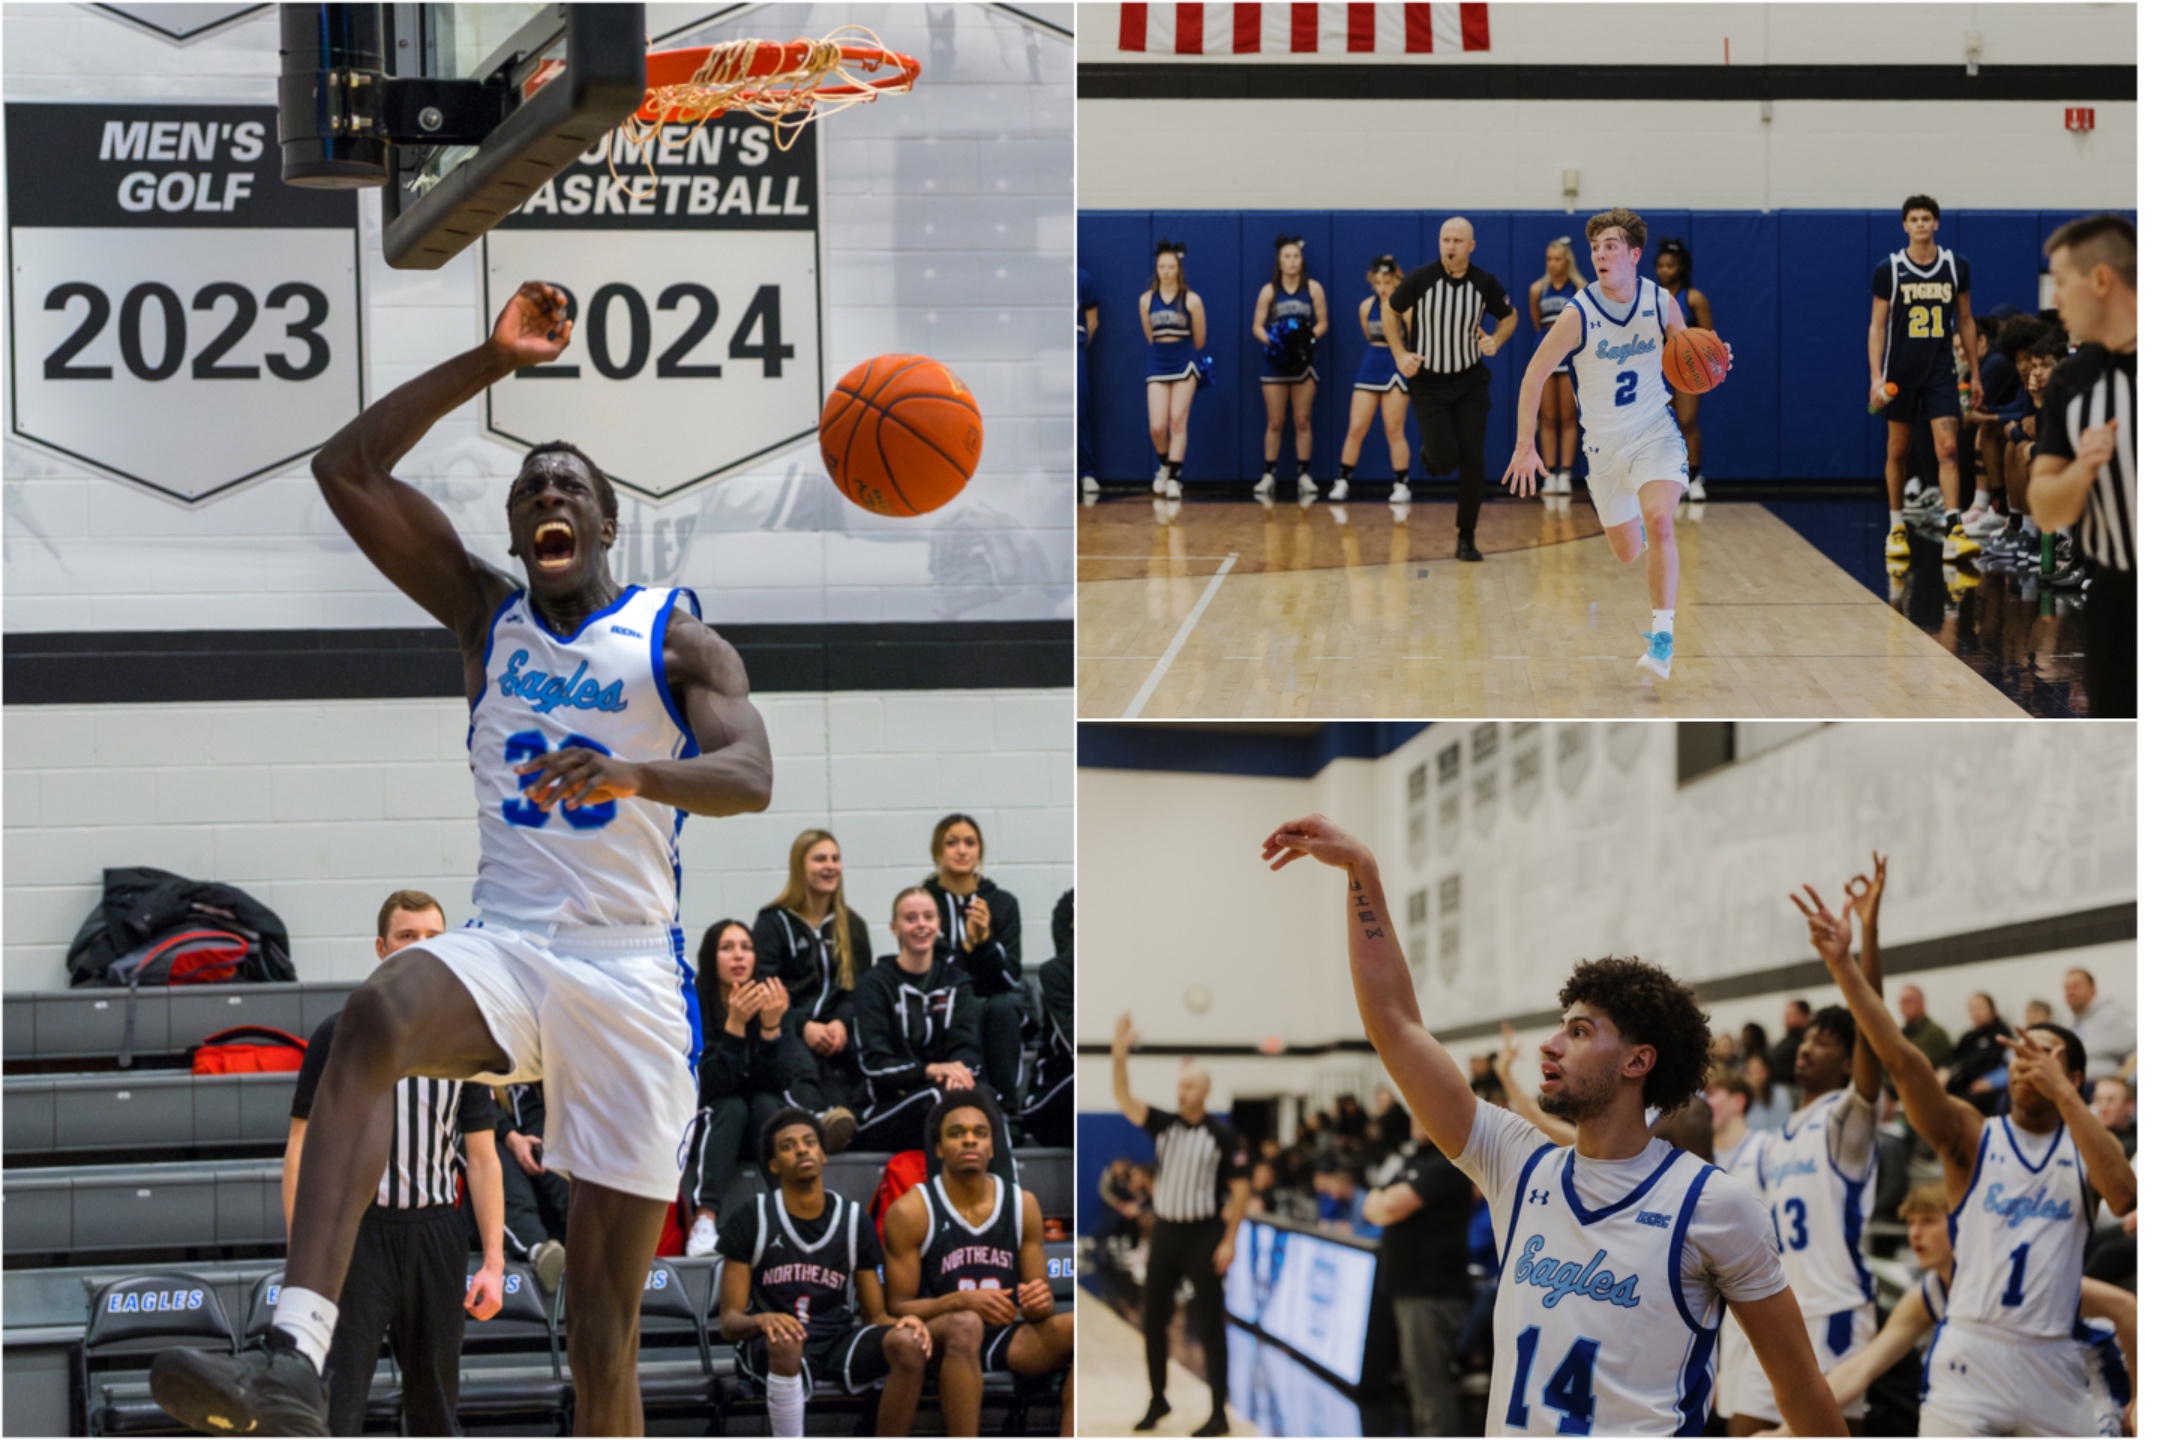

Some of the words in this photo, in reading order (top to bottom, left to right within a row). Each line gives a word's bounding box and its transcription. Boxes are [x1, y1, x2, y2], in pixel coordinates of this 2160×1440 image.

[99, 120, 266, 162] MEN'S
[576, 124, 771, 166] OMEN'S
[117, 170, 255, 213] GOLF
[508, 174, 810, 216] ASKETBALL
[1899, 281, 1953, 305] TIGERS
[43, 281, 331, 382] 2023
[1908, 305, 1945, 338] 21
[1595, 333, 1657, 365] Eagles
[1614, 369, 1639, 407] 2
[498, 649, 628, 714] Eagles
[1983, 1182, 2073, 1229] Eagles
[762, 1262, 847, 1291] NORTHEAST
[941, 1245, 1013, 1275] NORTHEAST
[1514, 1233, 1641, 1309] Eagles
[2001, 1241, 2030, 1307] 1
[107, 1289, 204, 1313] EAGLES
[795, 1294, 811, 1324] 1
[1504, 1323, 1602, 1437] 14
